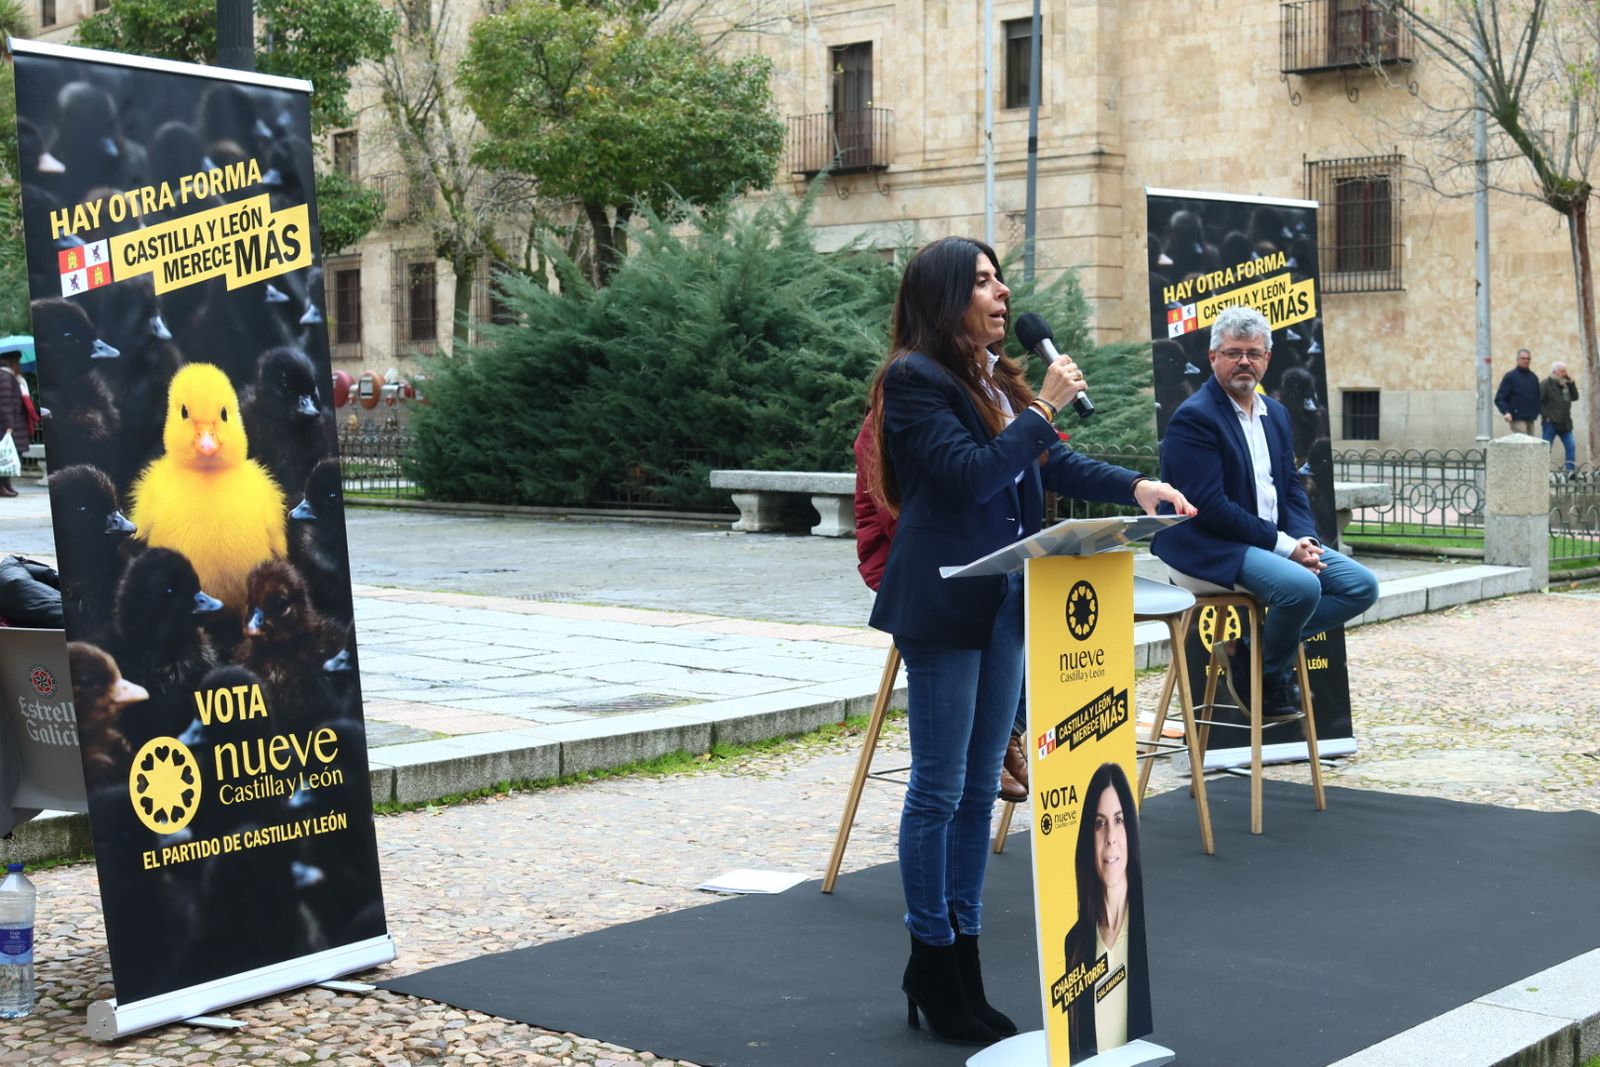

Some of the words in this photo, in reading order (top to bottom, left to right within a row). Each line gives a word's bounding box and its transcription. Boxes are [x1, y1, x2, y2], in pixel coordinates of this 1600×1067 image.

[50, 199, 102, 240] HAY
[108, 182, 175, 223] OTRA
[179, 158, 263, 204] FORMA
[124, 223, 205, 267] CASTILLA
[207, 219, 219, 243] Y
[220, 205, 263, 237] LEÓN
[163, 242, 233, 284] MERECE
[234, 218, 301, 278] MÁS
[1163, 278, 1194, 304] HAY
[1196, 267, 1235, 294] OTRA
[1236, 250, 1287, 279] FORMA
[1252, 288, 1259, 304] Y
[1261, 281, 1286, 301] LEÓN
[1269, 288, 1309, 325] MÁS
[1060, 648, 1105, 671] nueve
[1307, 656, 1329, 670] LEÓN
[18, 696, 77, 722] Estrell
[194, 683, 268, 726] VOTA
[1059, 710, 1089, 740] CASTILLA
[1089, 705, 1095, 718] Y
[1094, 694, 1111, 715] LEÓN
[1073, 716, 1099, 745] MERECE
[1100, 699, 1125, 735] MÁS
[26, 719, 79, 746] Galici
[214, 727, 339, 781] nueve
[219, 774, 285, 805] Castilla
[286, 777, 296, 799] y
[299, 766, 344, 791] León
[1040, 785, 1078, 810] VOTA
[1054, 810, 1077, 823] nueve
[143, 851, 160, 870] EL
[162, 838, 220, 866] PARTIDO
[223, 833, 241, 852] DE
[244, 823, 301, 849] CASTILLA
[301, 819, 311, 836] Y
[314, 810, 348, 835] LEÓN
[1054, 962, 1087, 1000] CHABELA
[1064, 987, 1075, 1007] DE
[1074, 979, 1085, 997] LA
[1084, 958, 1106, 988] TORRE
